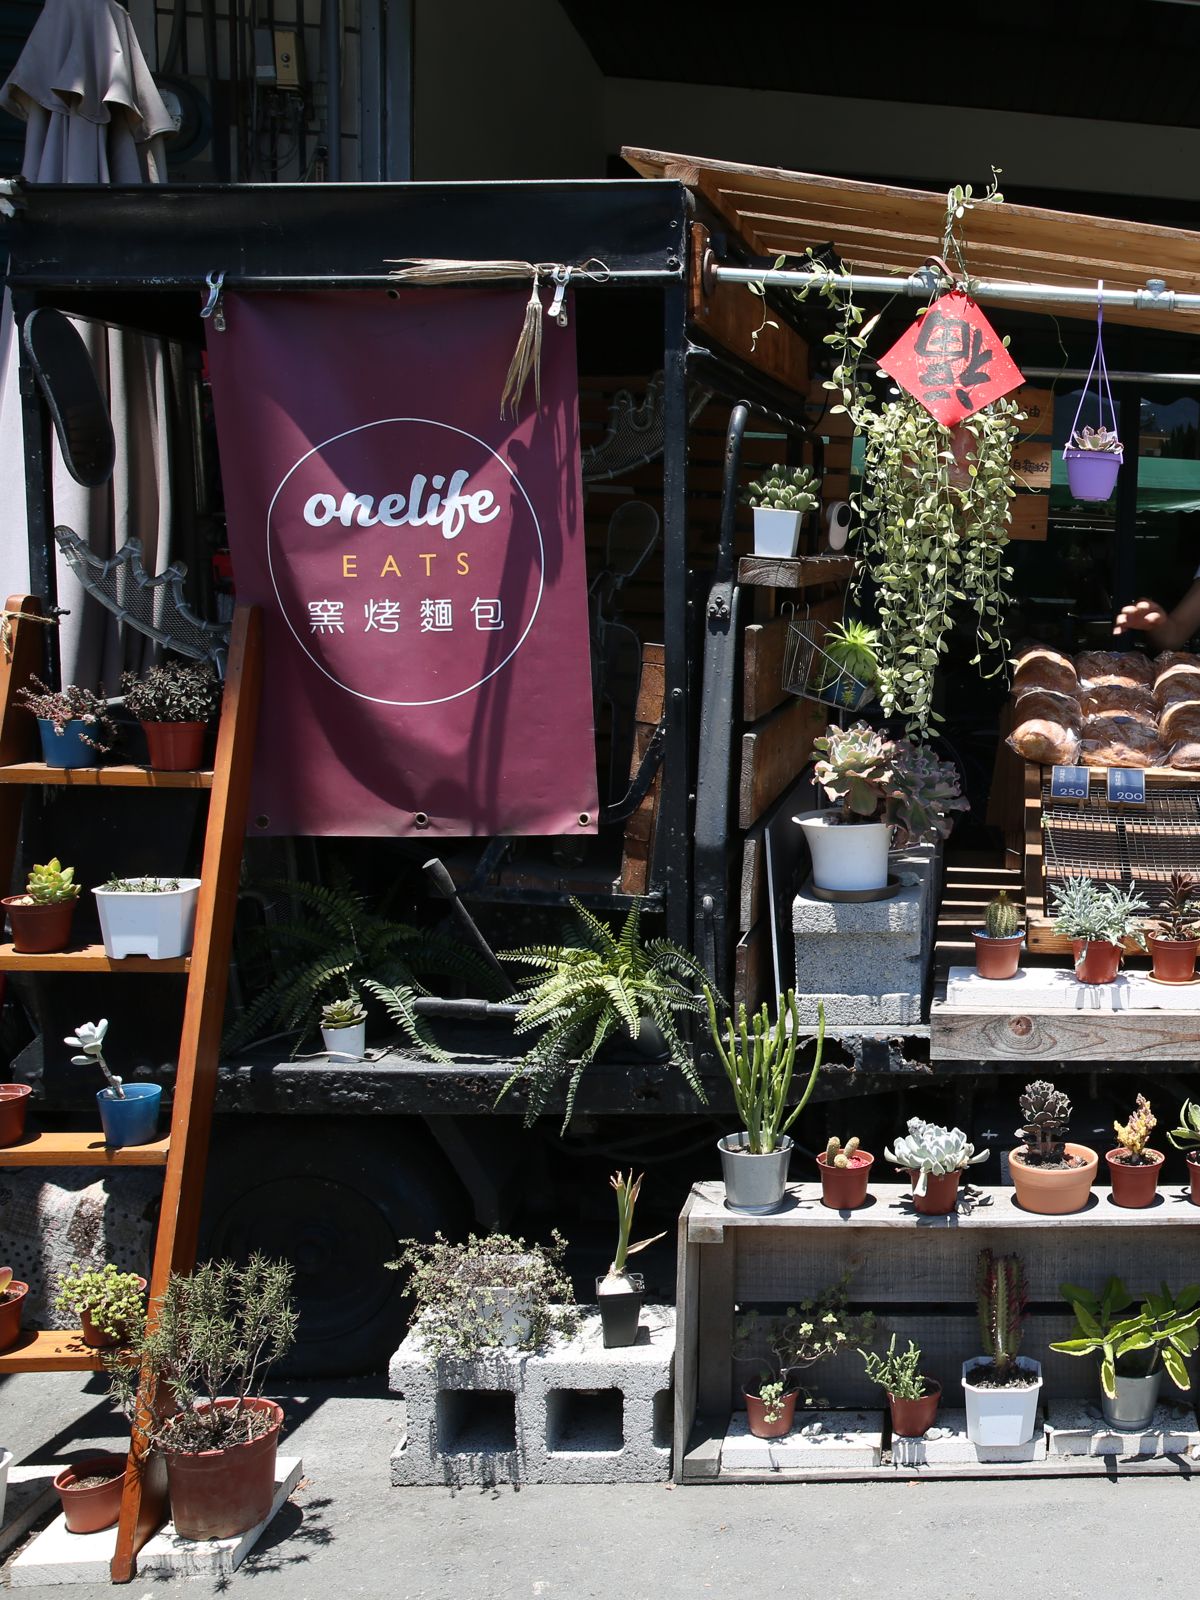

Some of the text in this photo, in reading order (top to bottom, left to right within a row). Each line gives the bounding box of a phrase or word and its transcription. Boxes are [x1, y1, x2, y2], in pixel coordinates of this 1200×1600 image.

[303, 470, 500, 539] onelife
[342, 551, 471, 577] EATS
[308, 597, 504, 634] 窯烤麵包
[1060, 788, 1085, 796] 250
[1117, 791, 1143, 801] 200
